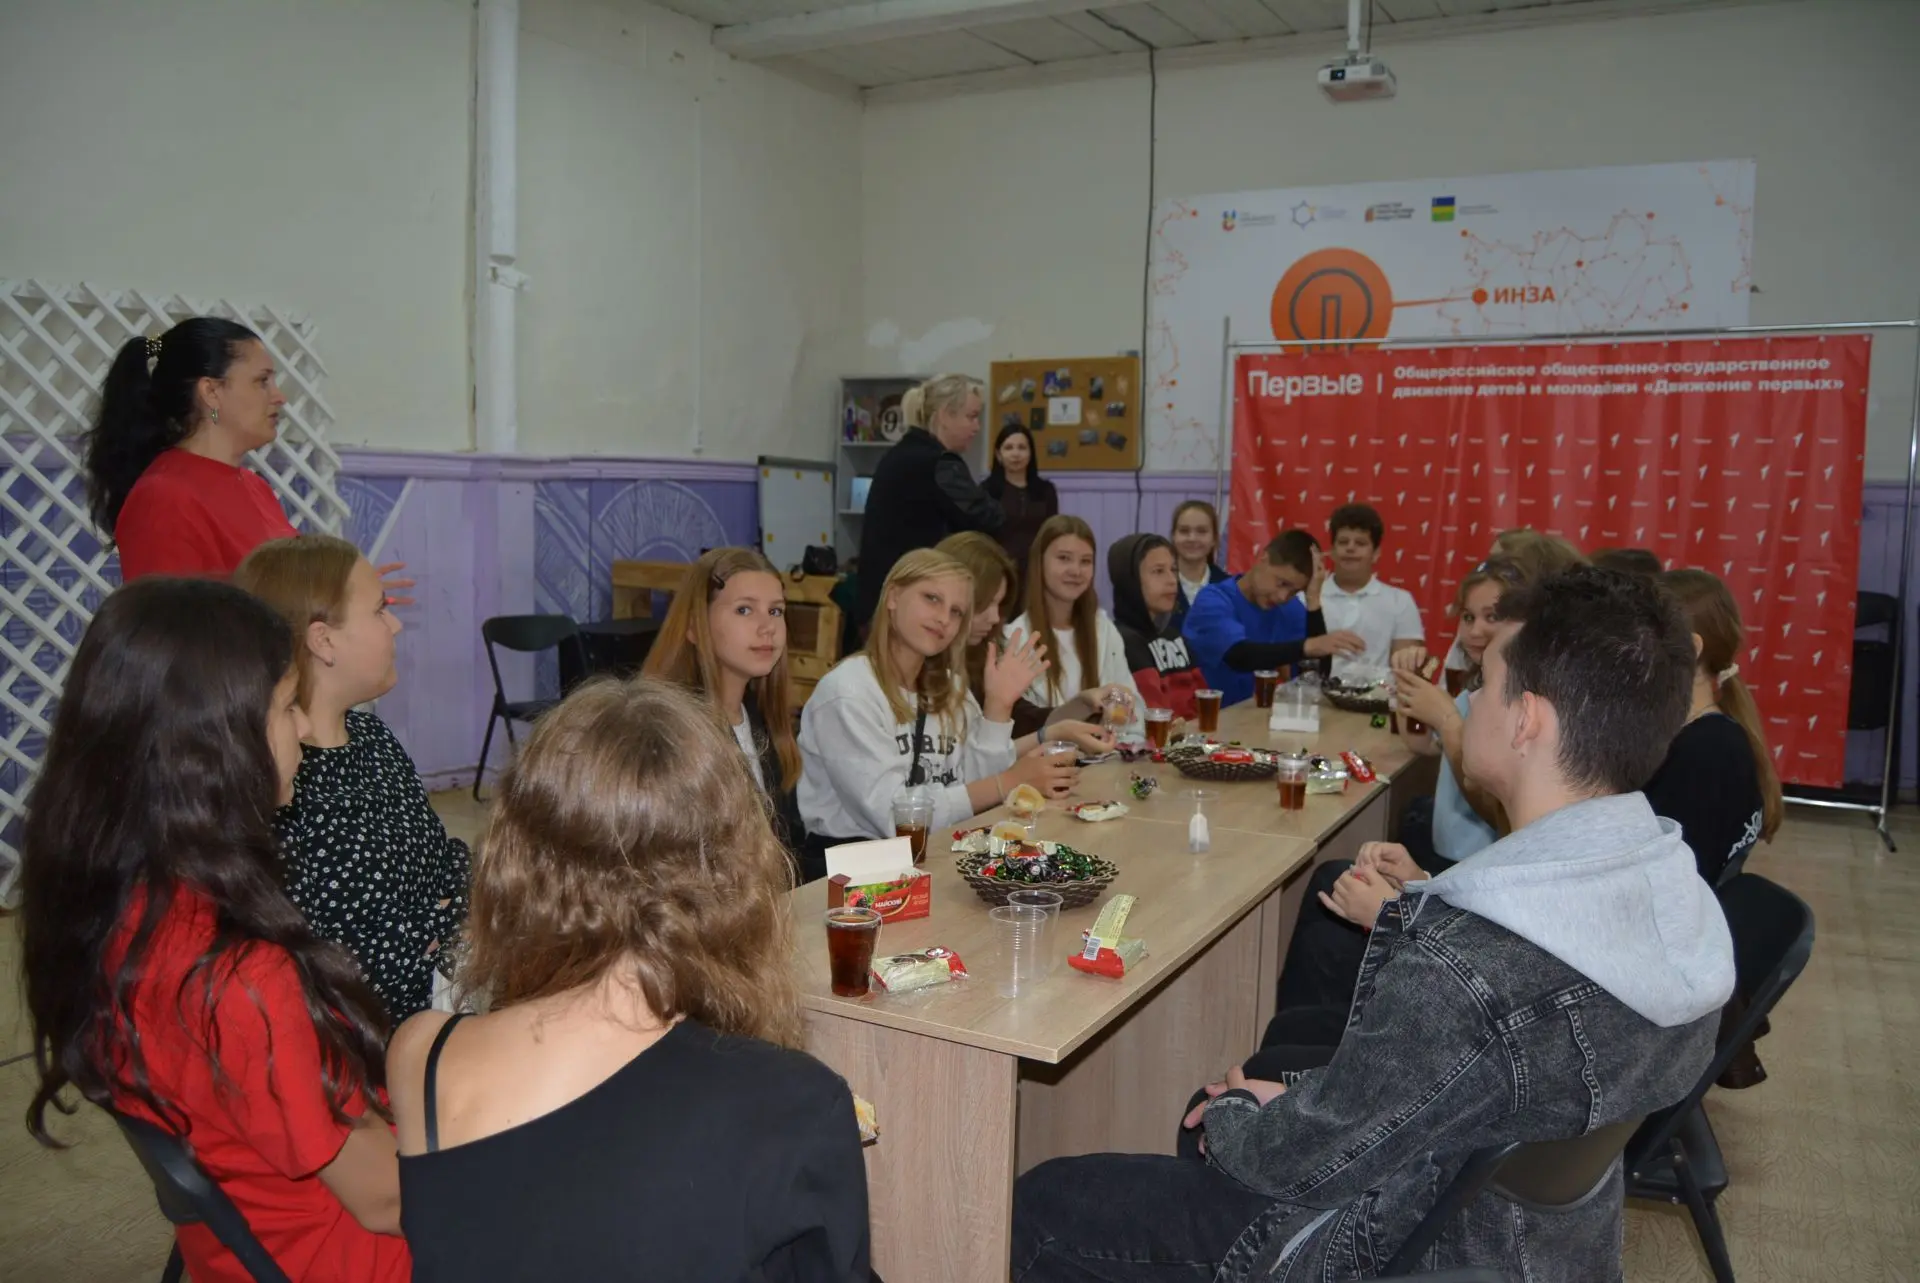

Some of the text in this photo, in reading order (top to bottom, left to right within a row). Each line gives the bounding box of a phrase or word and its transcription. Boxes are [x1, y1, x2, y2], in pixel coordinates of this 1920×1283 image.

[1494, 285, 1555, 304] ИНЗА
[1393, 364, 1536, 381] Общероссийское
[1248, 370, 1363, 405] Первые
[1392, 383, 1474, 399] движение
[1477, 381, 1527, 397] детей
[1530, 383, 1542, 395] и
